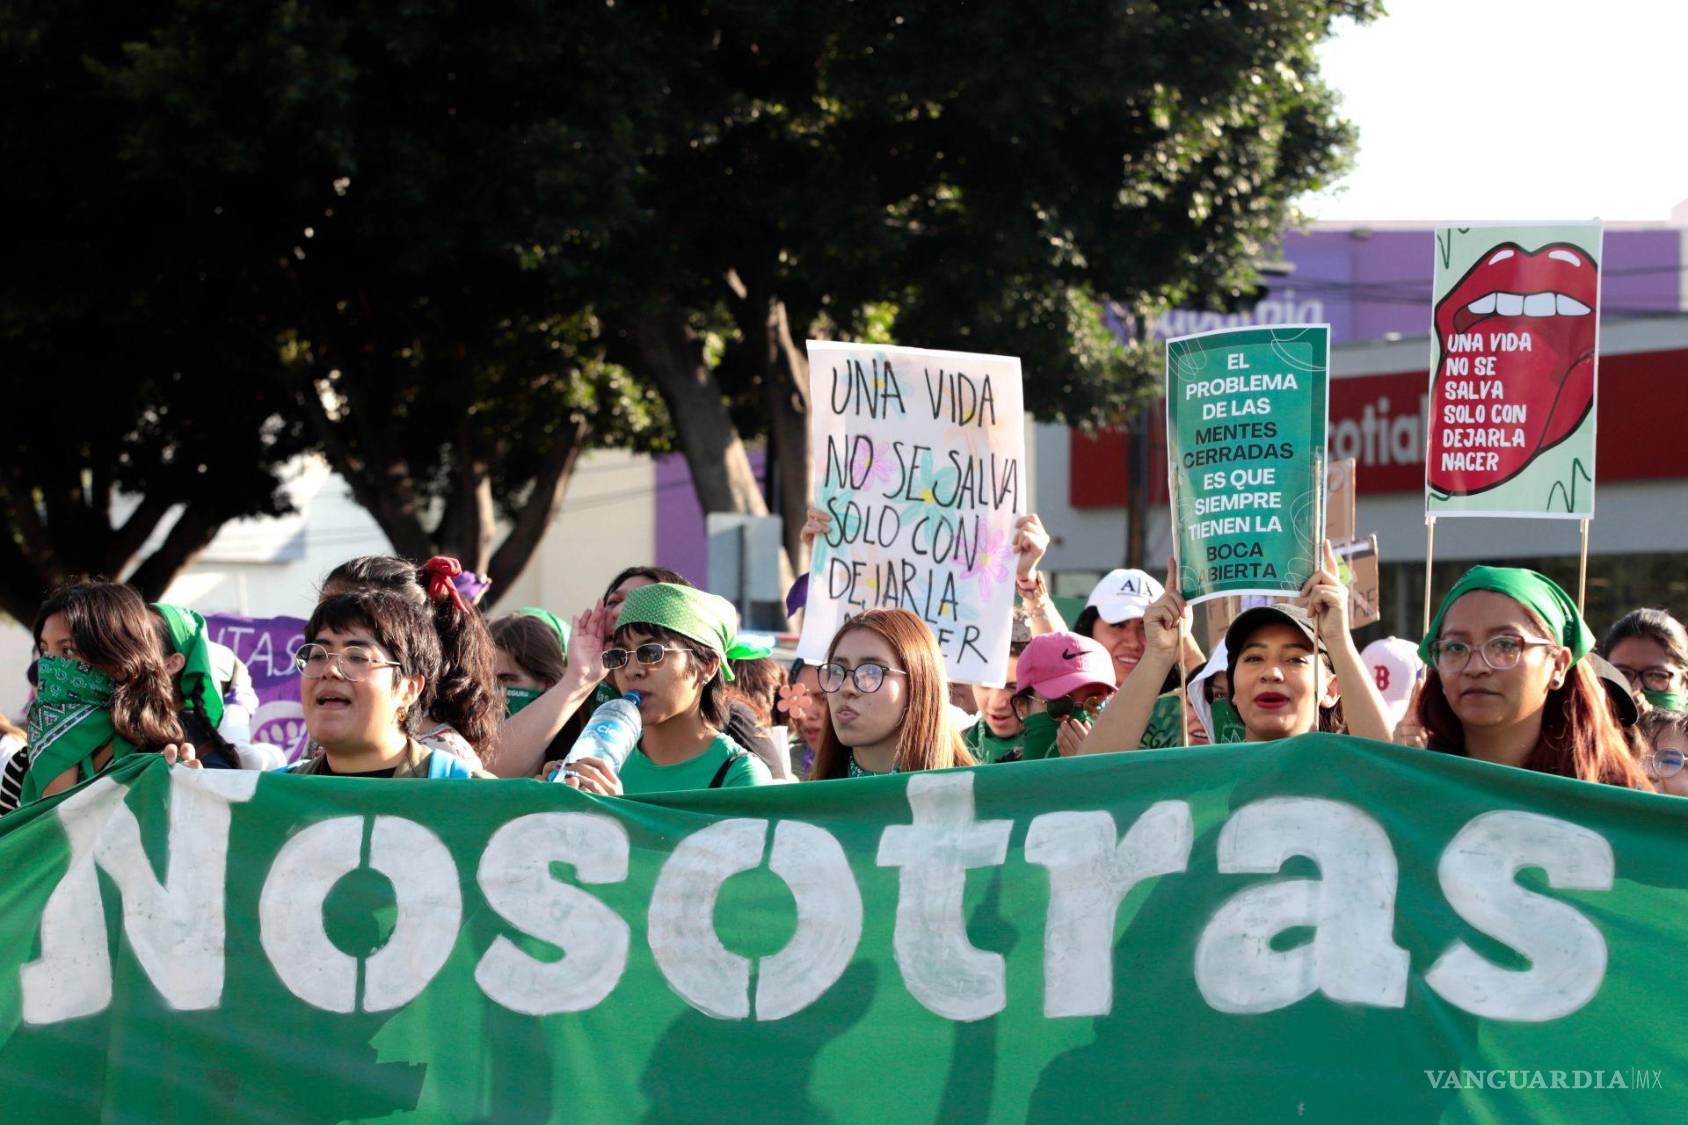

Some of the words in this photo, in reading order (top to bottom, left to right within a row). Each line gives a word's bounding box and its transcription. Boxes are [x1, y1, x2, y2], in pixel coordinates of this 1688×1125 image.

[1447, 333, 1484, 352] UNA
[1490, 332, 1532, 352] VIDA
[1227, 353, 1250, 370] EL
[1446, 357, 1468, 376] NO
[1475, 357, 1497, 376] SE
[831, 358, 906, 419] UNA
[925, 368, 996, 427] VIDA
[1186, 373, 1298, 400] PROBLEMA
[1445, 380, 1504, 400] SALVA
[1202, 402, 1227, 420] DE
[1231, 397, 1271, 416] LAS
[1443, 404, 1485, 424] SOLO
[1491, 404, 1527, 424] CON
[1195, 421, 1278, 445] MENTES
[1443, 428, 1525, 448] DEJARLA
[1183, 443, 1294, 469] CERRADAS
[1441, 452, 1499, 472] NACER
[824, 434, 875, 490] NO
[883, 441, 932, 502] SE
[932, 450, 1018, 514] SALVA
[1203, 472, 1225, 490] ES
[1230, 468, 1275, 490] QUE
[1195, 491, 1282, 516] SIEMPRE
[825, 496, 901, 548] SOLO
[912, 515, 980, 571] CON
[1189, 517, 1250, 541] TIENEN
[1255, 515, 1282, 533] LA
[1207, 541, 1264, 562] BOCA
[1200, 563, 1277, 582] BIERTA
[829, 557, 959, 625] DEJARLA
[21, 766, 1615, 1026] Nosotras
